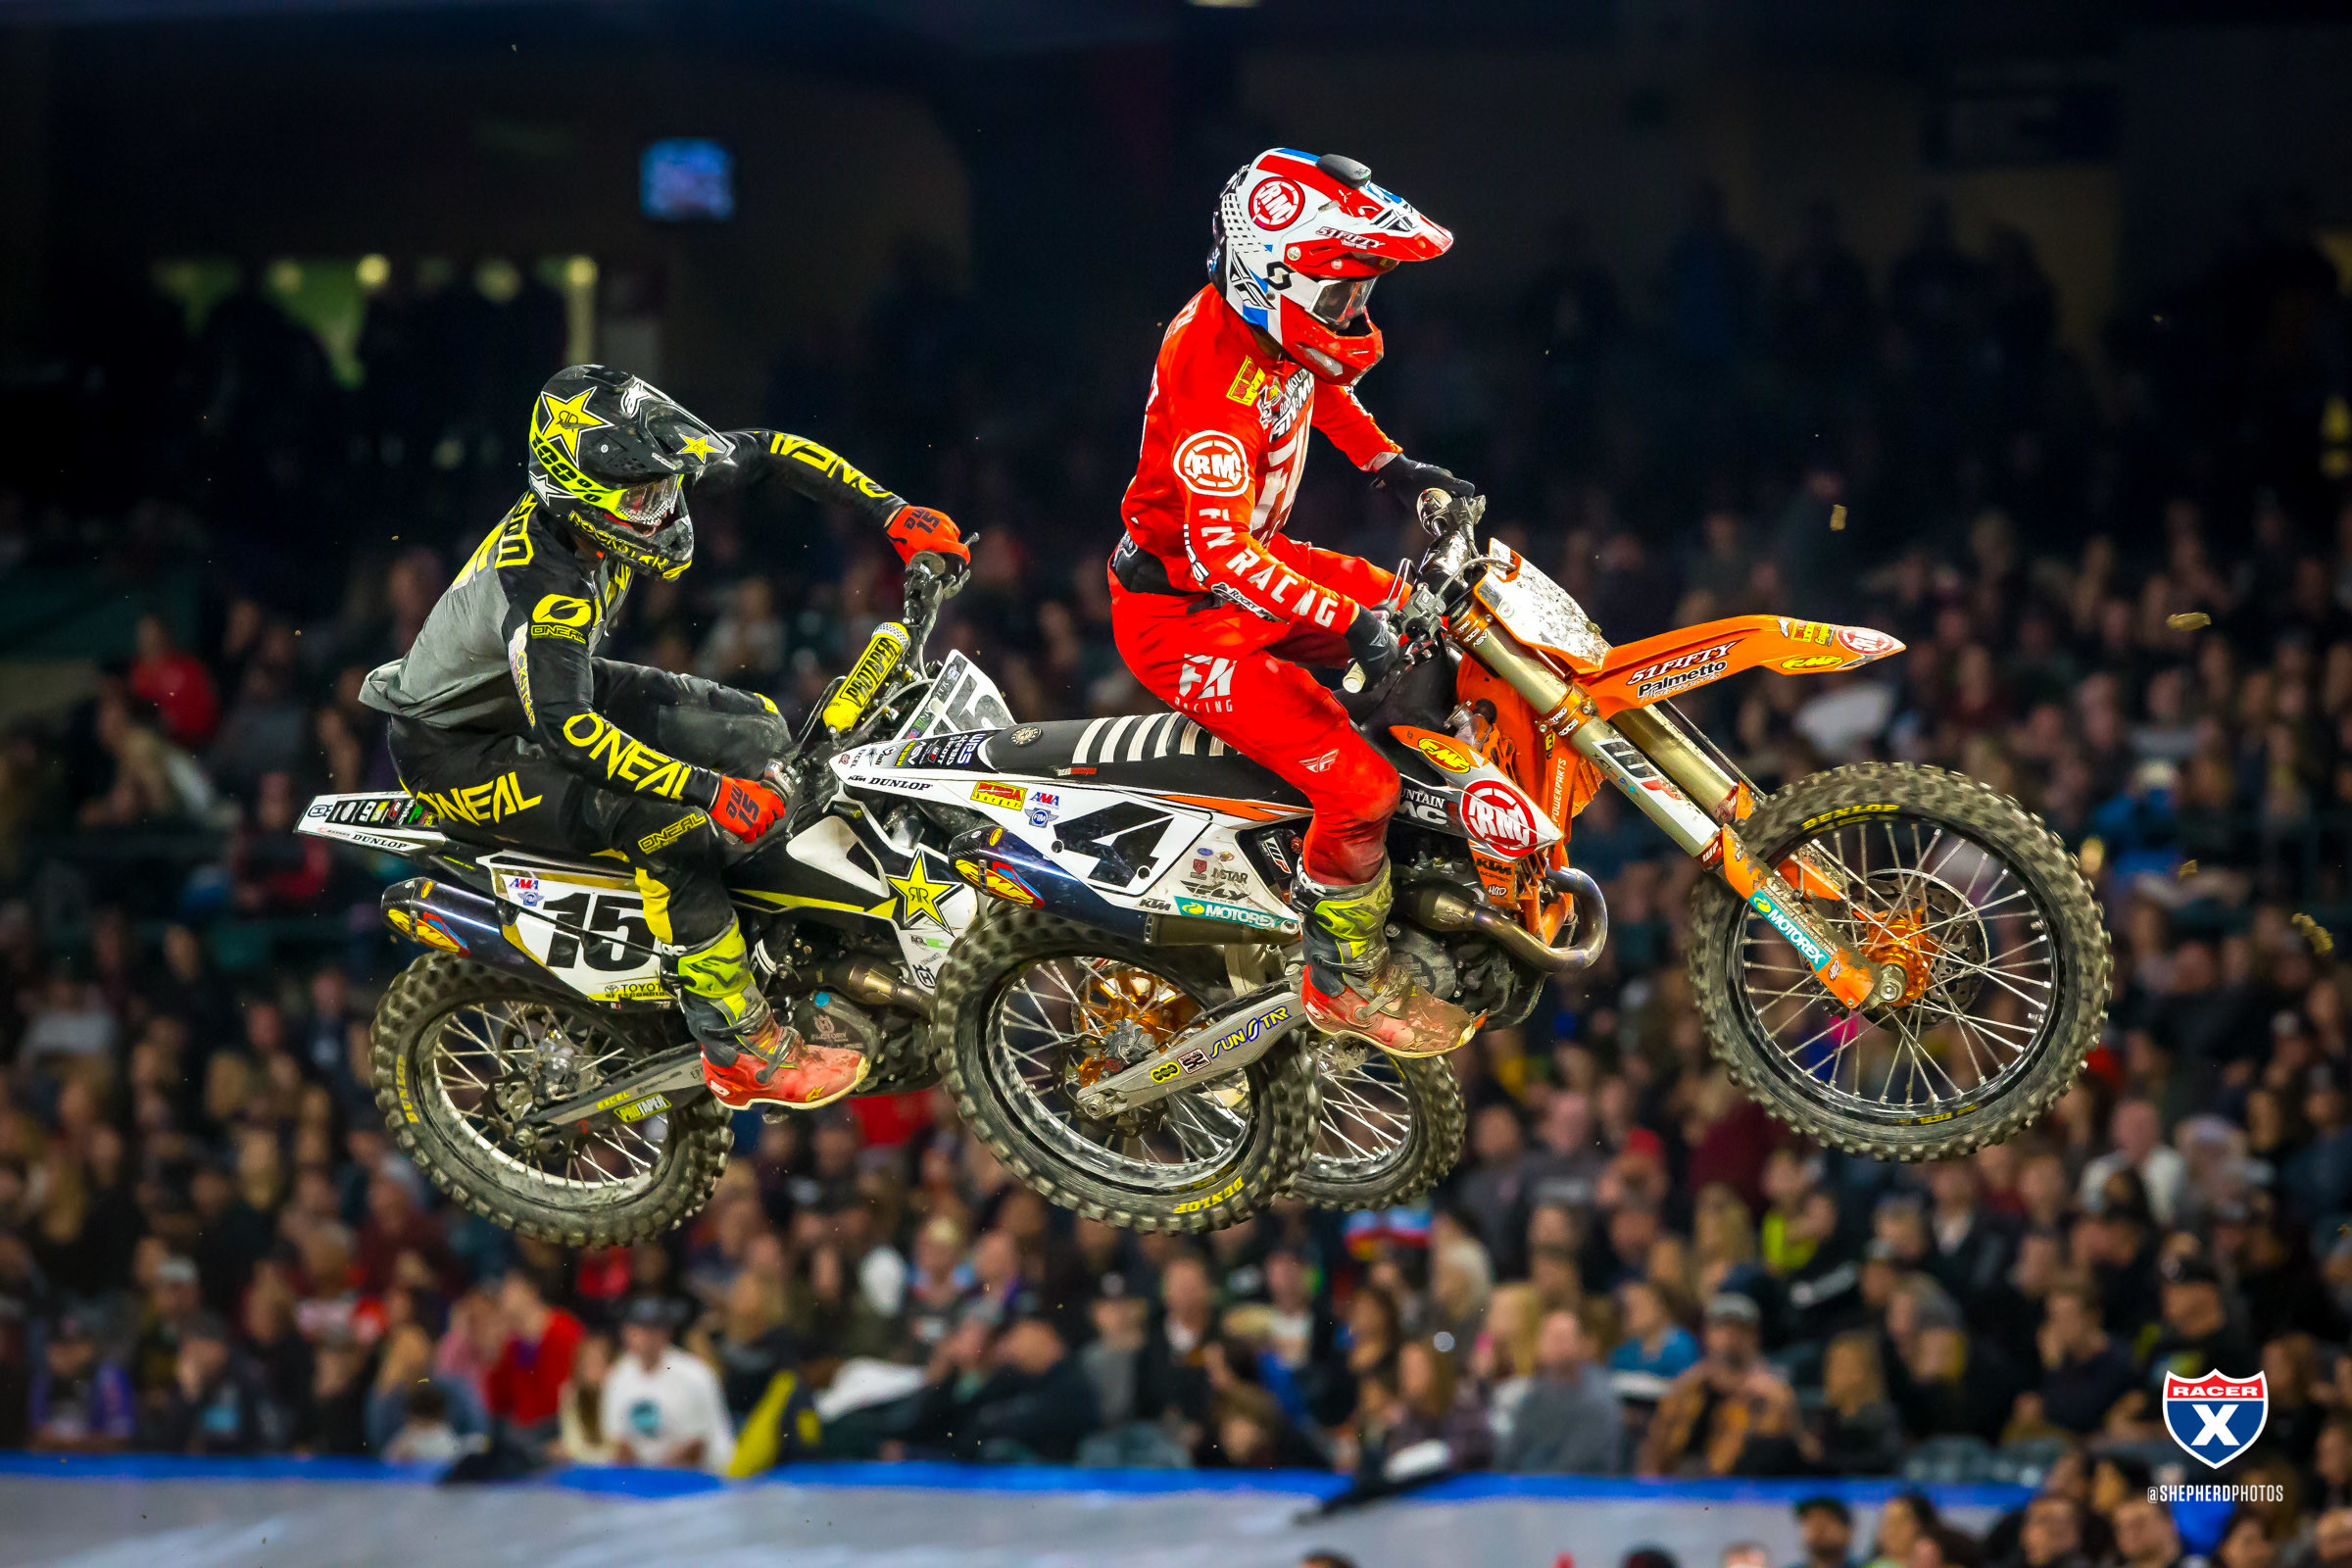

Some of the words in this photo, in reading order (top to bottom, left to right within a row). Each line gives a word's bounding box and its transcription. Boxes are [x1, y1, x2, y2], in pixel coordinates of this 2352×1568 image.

[1316, 225, 1386, 249] 51FIFTY
[532, 433, 603, 504] 100%
[916, 514, 941, 535] 15
[1627, 637, 1747, 686] 51FIFTY
[1638, 661, 1728, 698] Palmetto
[563, 710, 694, 802] O'NEAL
[1418, 740, 1470, 771] FMF
[868, 777, 932, 791] DUNLOP
[1029, 791, 1060, 807] AMA
[1551, 758, 1567, 823] POWERPARTS
[740, 787, 760, 830] 15
[1801, 804, 1901, 831] DUNLOP
[352, 833, 409, 850] DUNLOP
[637, 812, 707, 852] ONEAL
[1053, 801, 1175, 889] 4
[1476, 857, 1512, 876] KTM
[509, 877, 539, 890] AMA
[1138, 897, 1172, 911] KTM
[542, 892, 658, 972] 15
[1767, 908, 1826, 965] MOTOREX
[620, 983, 667, 993] TOYOT
[596, 1090, 632, 1111] EXCEL
[618, 1093, 669, 1122] PROTAPER
[1173, 1176, 1245, 1214] DUNLOP
